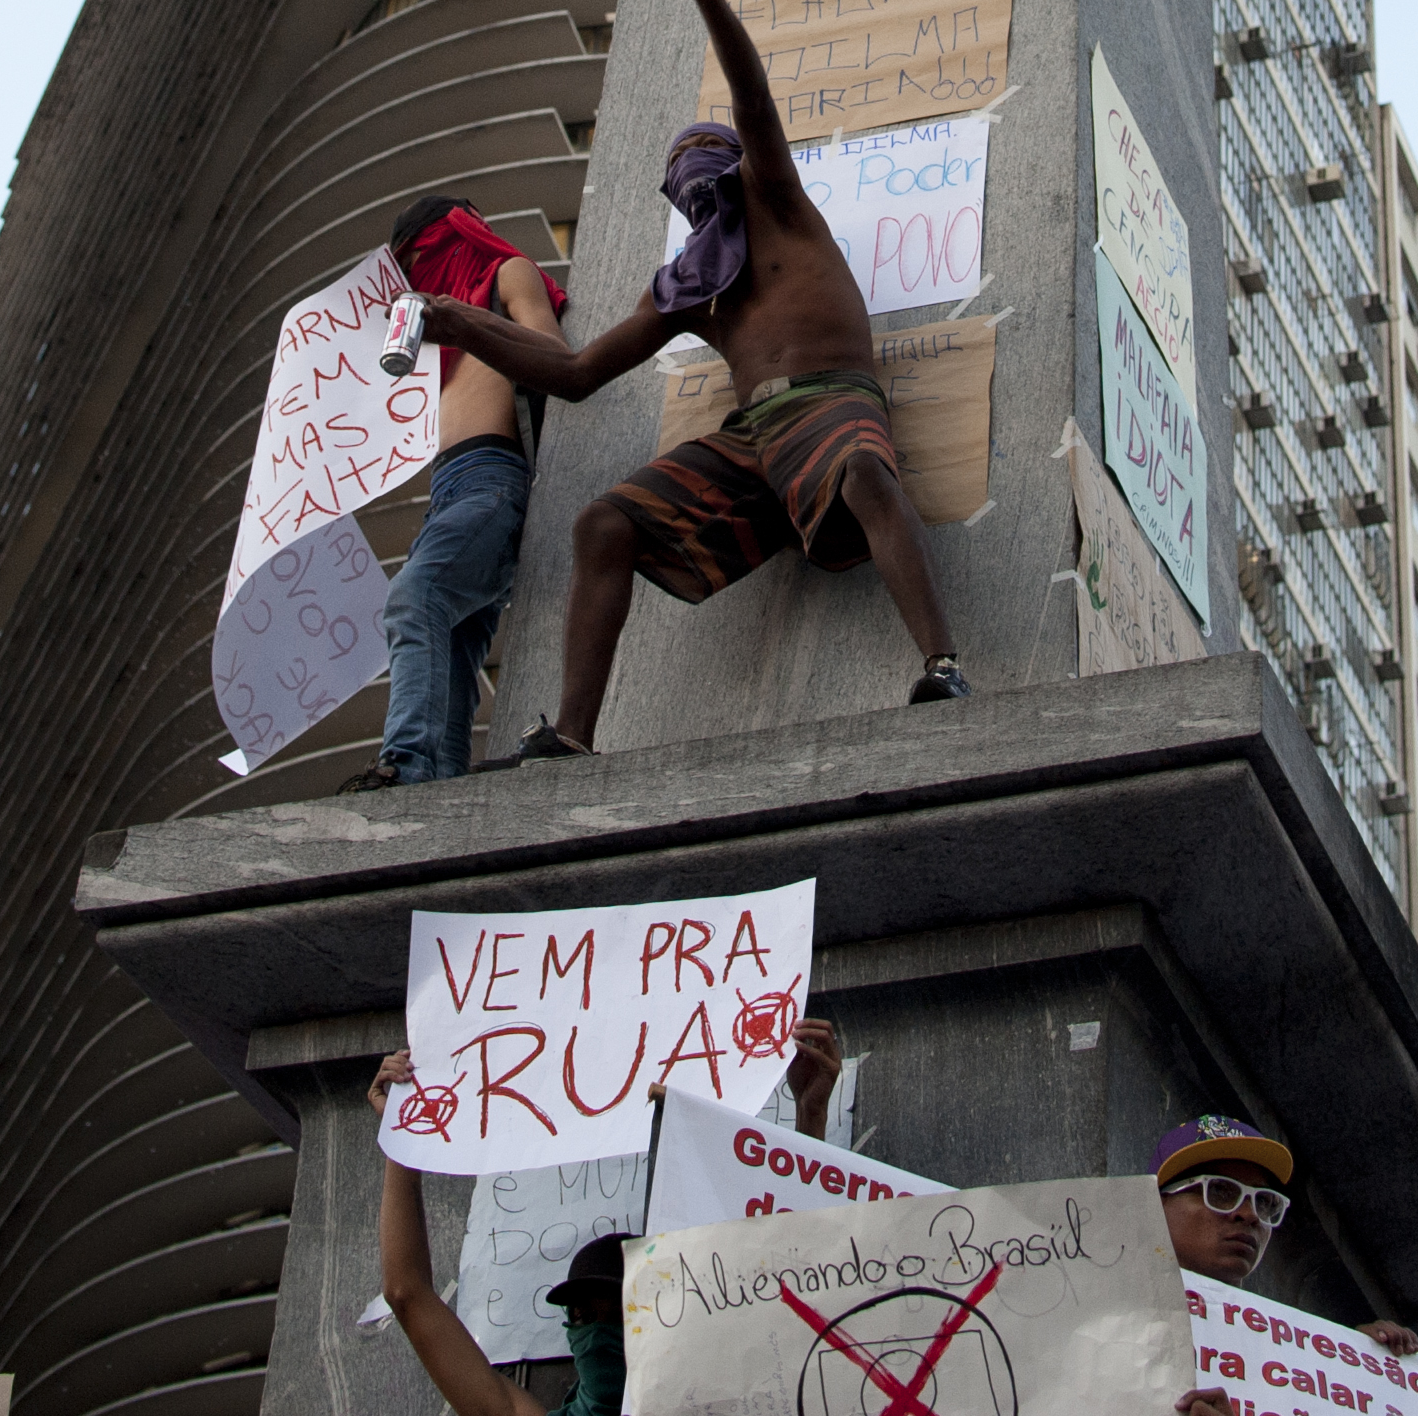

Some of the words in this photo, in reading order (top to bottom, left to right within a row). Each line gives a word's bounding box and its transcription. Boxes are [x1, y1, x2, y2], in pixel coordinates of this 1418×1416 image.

[760, 6, 979, 81] DILMA
[854, 146, 982, 202] Poder
[1107, 109, 1164, 229] CHEGA
[1125, 181, 1153, 238] DE
[1103, 187, 1193, 363] CENSURA
[882, 332, 964, 366] AQUI
[889, 367, 940, 408] É
[1114, 305, 1193, 476] MALAFAIA
[270, 413, 369, 483] MAS
[386, 386, 429, 424] O
[436, 929, 595, 1013] VEM
[639, 910, 771, 995] PRA
[451, 1000, 728, 1139] RUA
[745, 1191, 794, 1218] d
[1192, 1345, 1246, 1381] ra
[1261, 1360, 1374, 1415] calar
